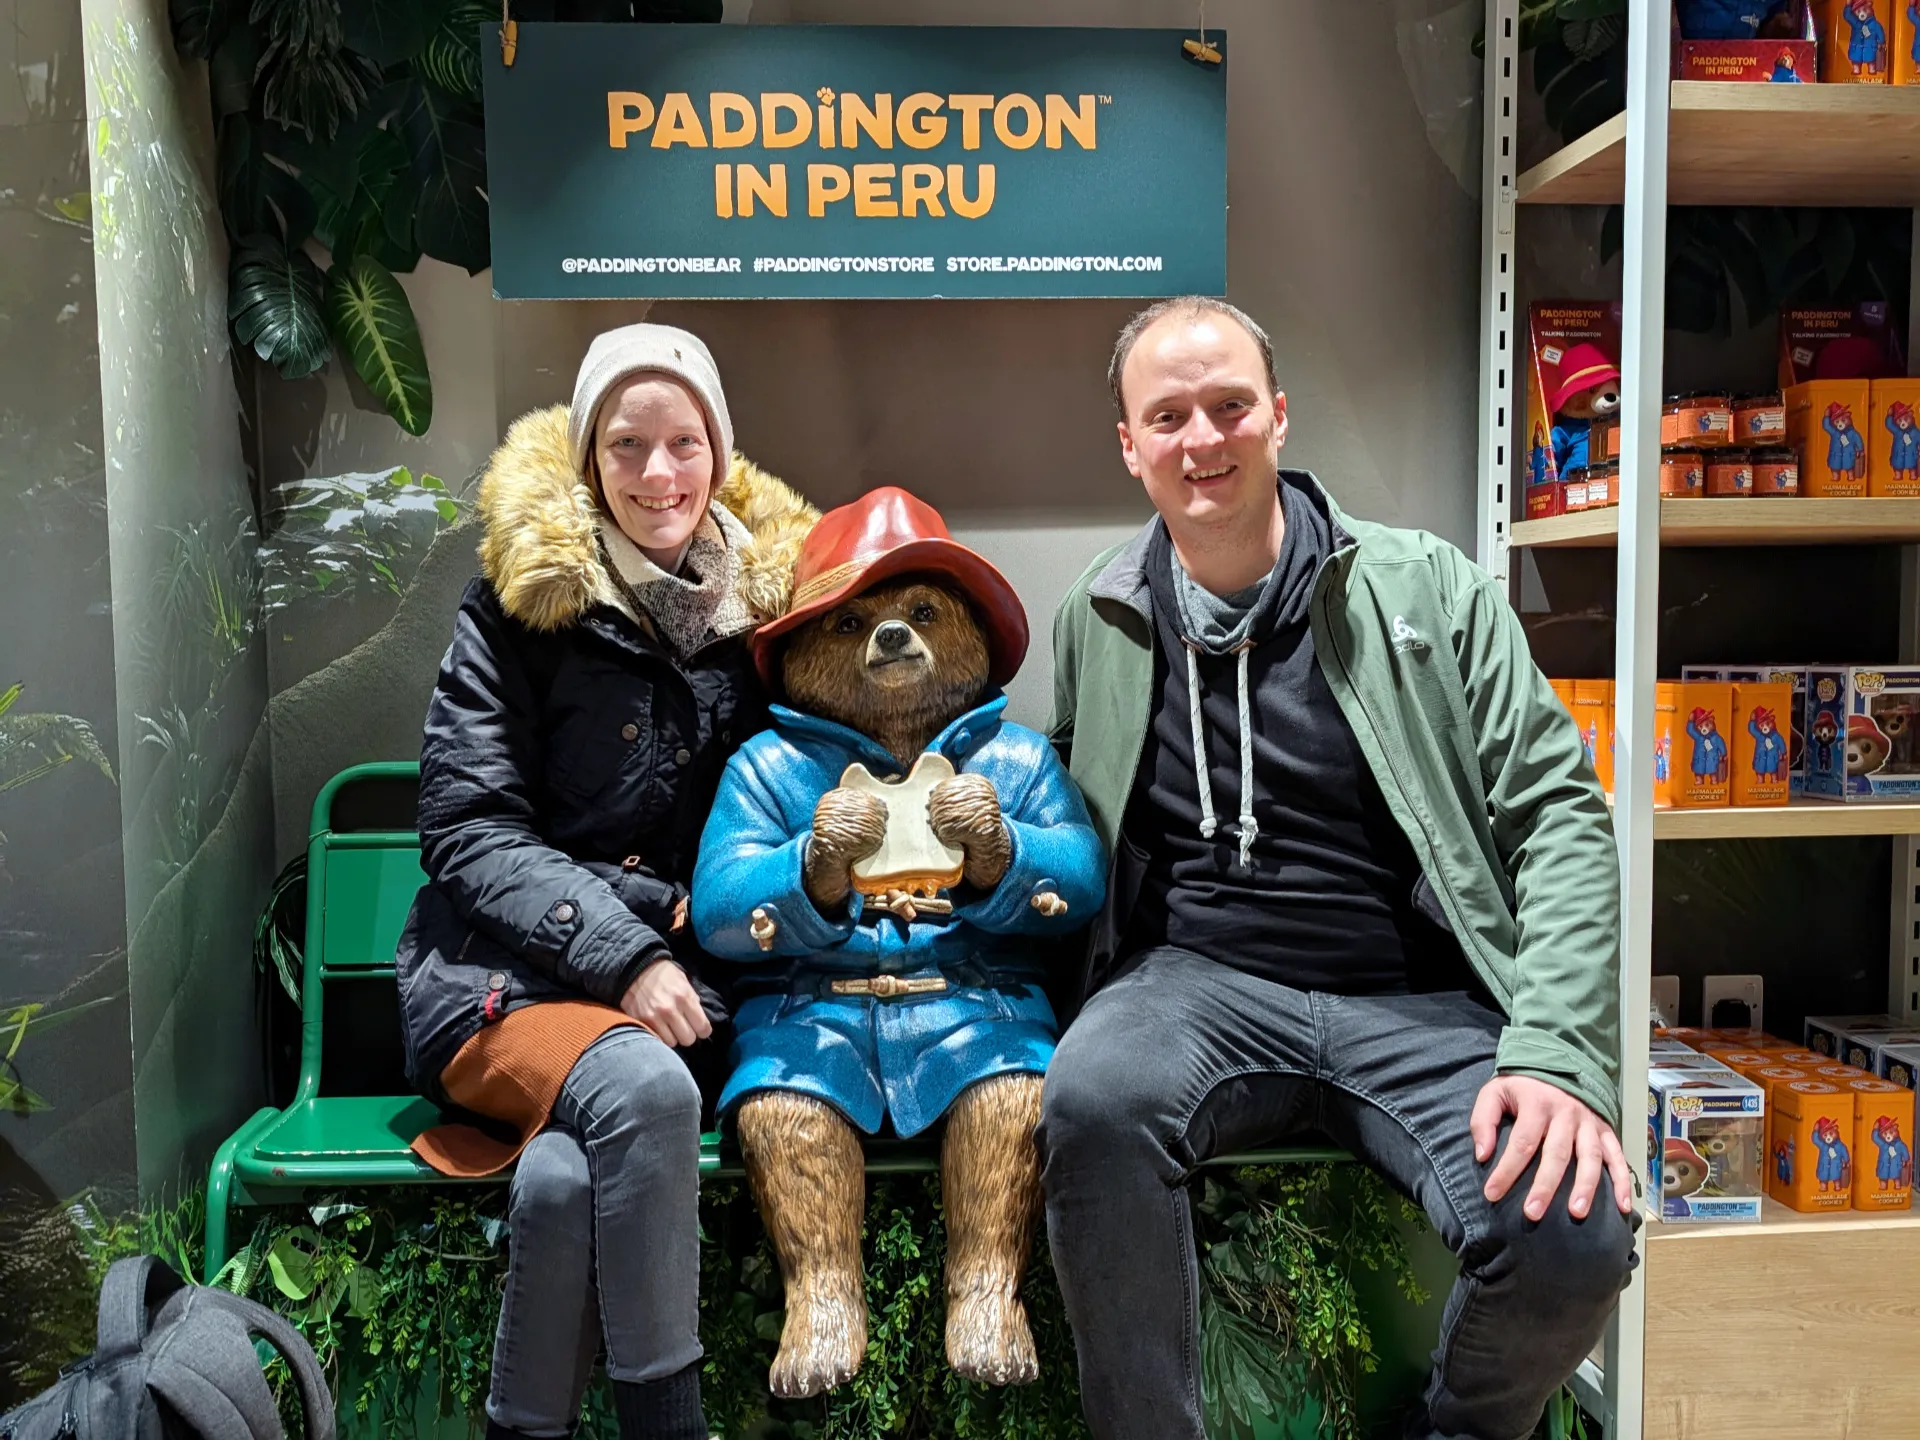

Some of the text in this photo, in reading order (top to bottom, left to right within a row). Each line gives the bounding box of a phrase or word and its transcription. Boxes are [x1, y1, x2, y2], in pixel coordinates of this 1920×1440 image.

[1692, 57, 1757, 66] PADDINGTON
[1705, 66, 1743, 75] IN PERU
[607, 86, 1097, 150] PADDINGTON
[715, 163, 996, 219] IN PERU
[562, 256, 1163, 273] @PADDINGTONBEAR #PADDINGTONSTORE STORE.PADDINGTON.COM
[1540, 310, 1601, 318] PADDINGTON
[1791, 311, 1851, 319] PADDINGTON
[1553, 319, 1589, 327] IN PERU
[1803, 320, 1839, 328] IN PERU
[1854, 671, 1885, 691] POP!
[1879, 780, 1917, 788] PADDINGTON
[1671, 1096, 1703, 1112] POP!
[1697, 1202, 1737, 1210] PADDINGTON
